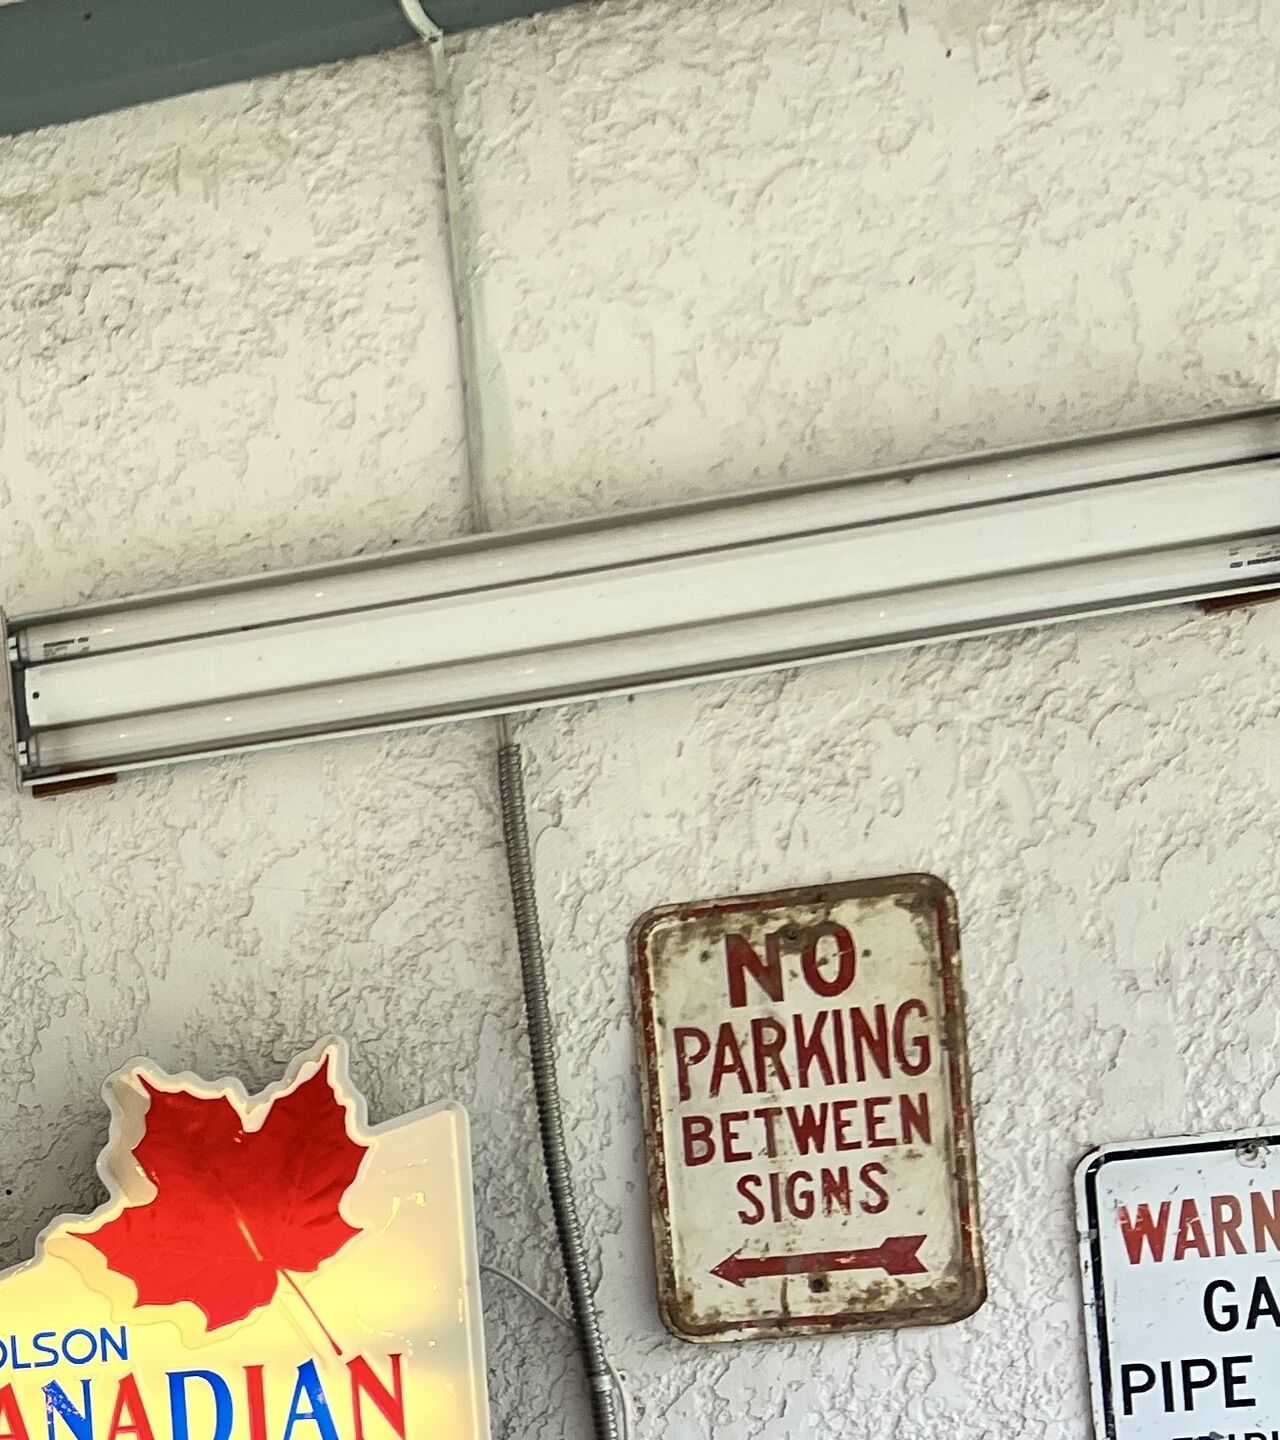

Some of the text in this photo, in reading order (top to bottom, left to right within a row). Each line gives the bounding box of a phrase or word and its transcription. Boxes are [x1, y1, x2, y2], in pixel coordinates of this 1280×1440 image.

[724, 921, 857, 1009] NO
[673, 998, 933, 1102] PARKING
[681, 1092, 933, 1167] BETWEEN
[737, 1161, 890, 1226] SIGNS
[1121, 1355, 1256, 1416] PIPE
